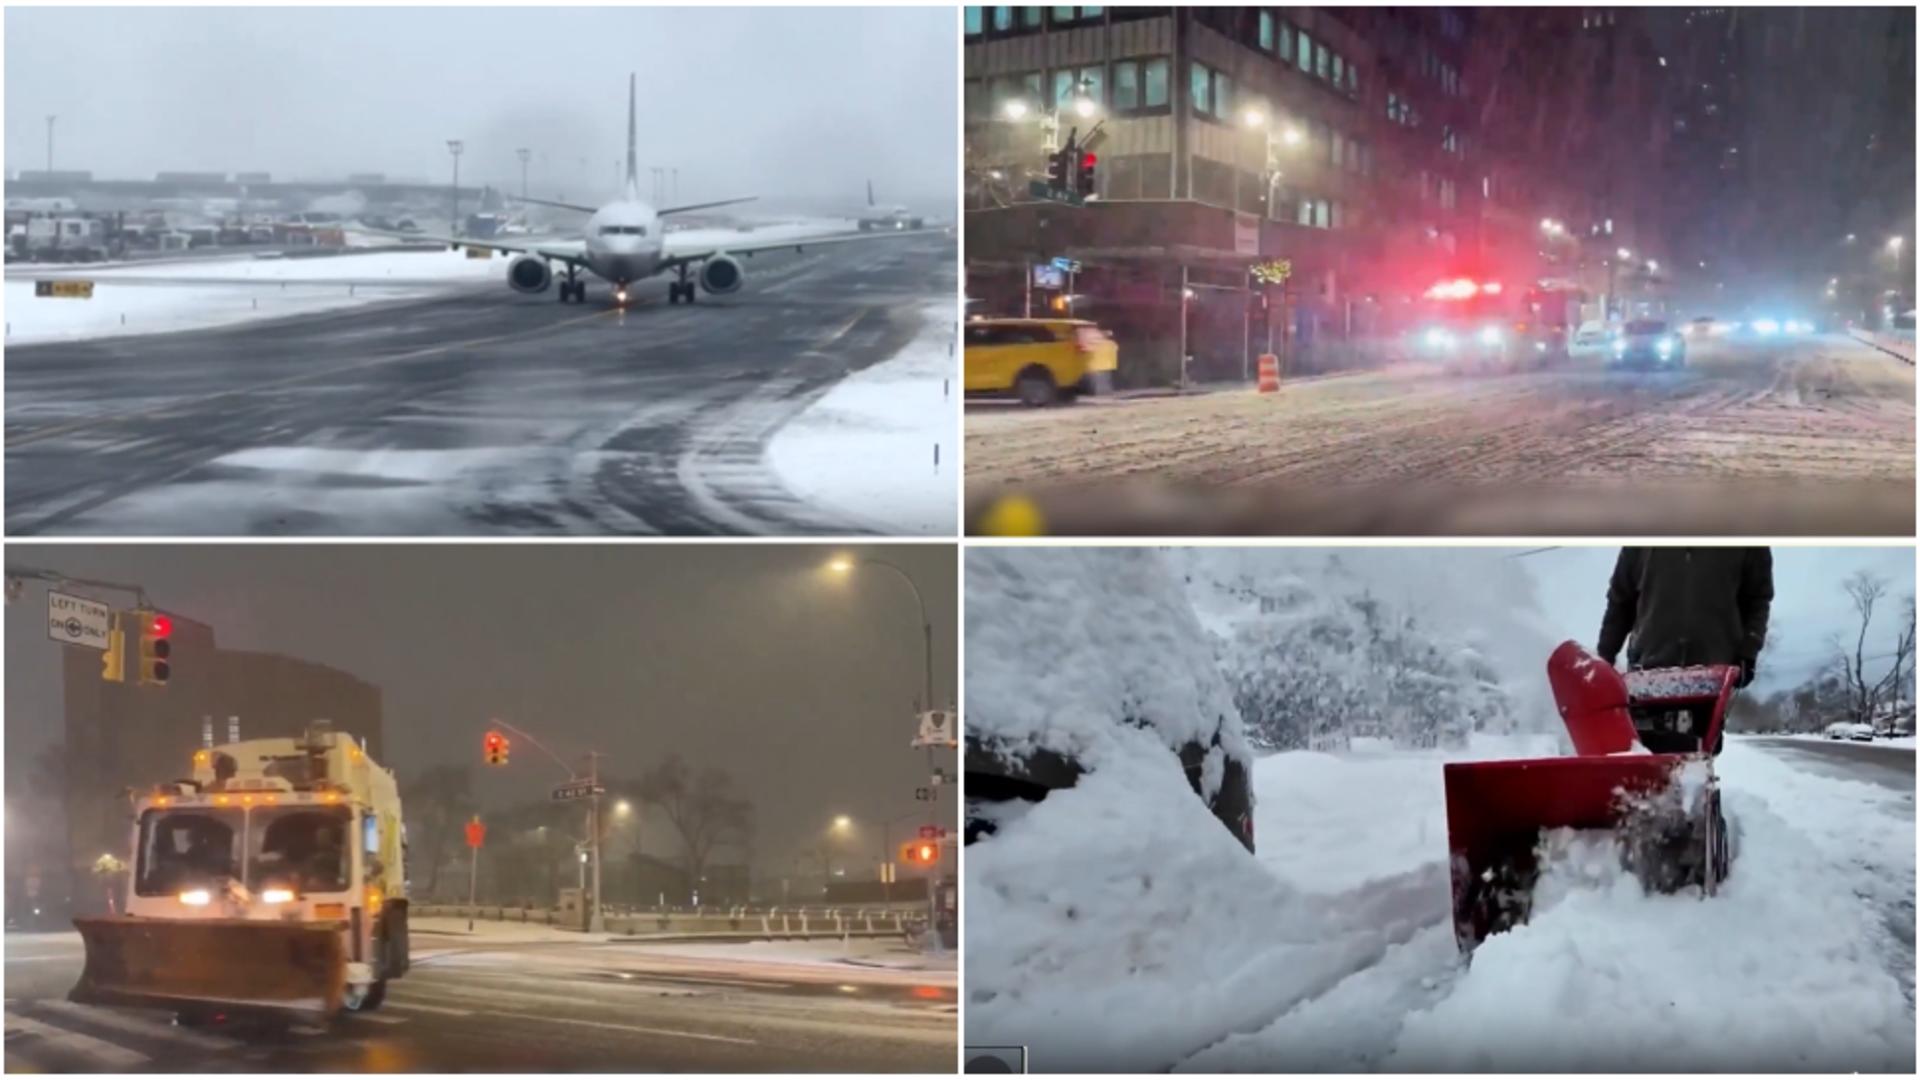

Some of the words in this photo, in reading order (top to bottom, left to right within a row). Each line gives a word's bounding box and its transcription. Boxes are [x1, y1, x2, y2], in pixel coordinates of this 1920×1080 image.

[51, 596, 76, 612] LEFT
[80, 603, 106, 619] TURN
[51, 618, 65, 629] ON
[83, 624, 106, 639] ONLY
